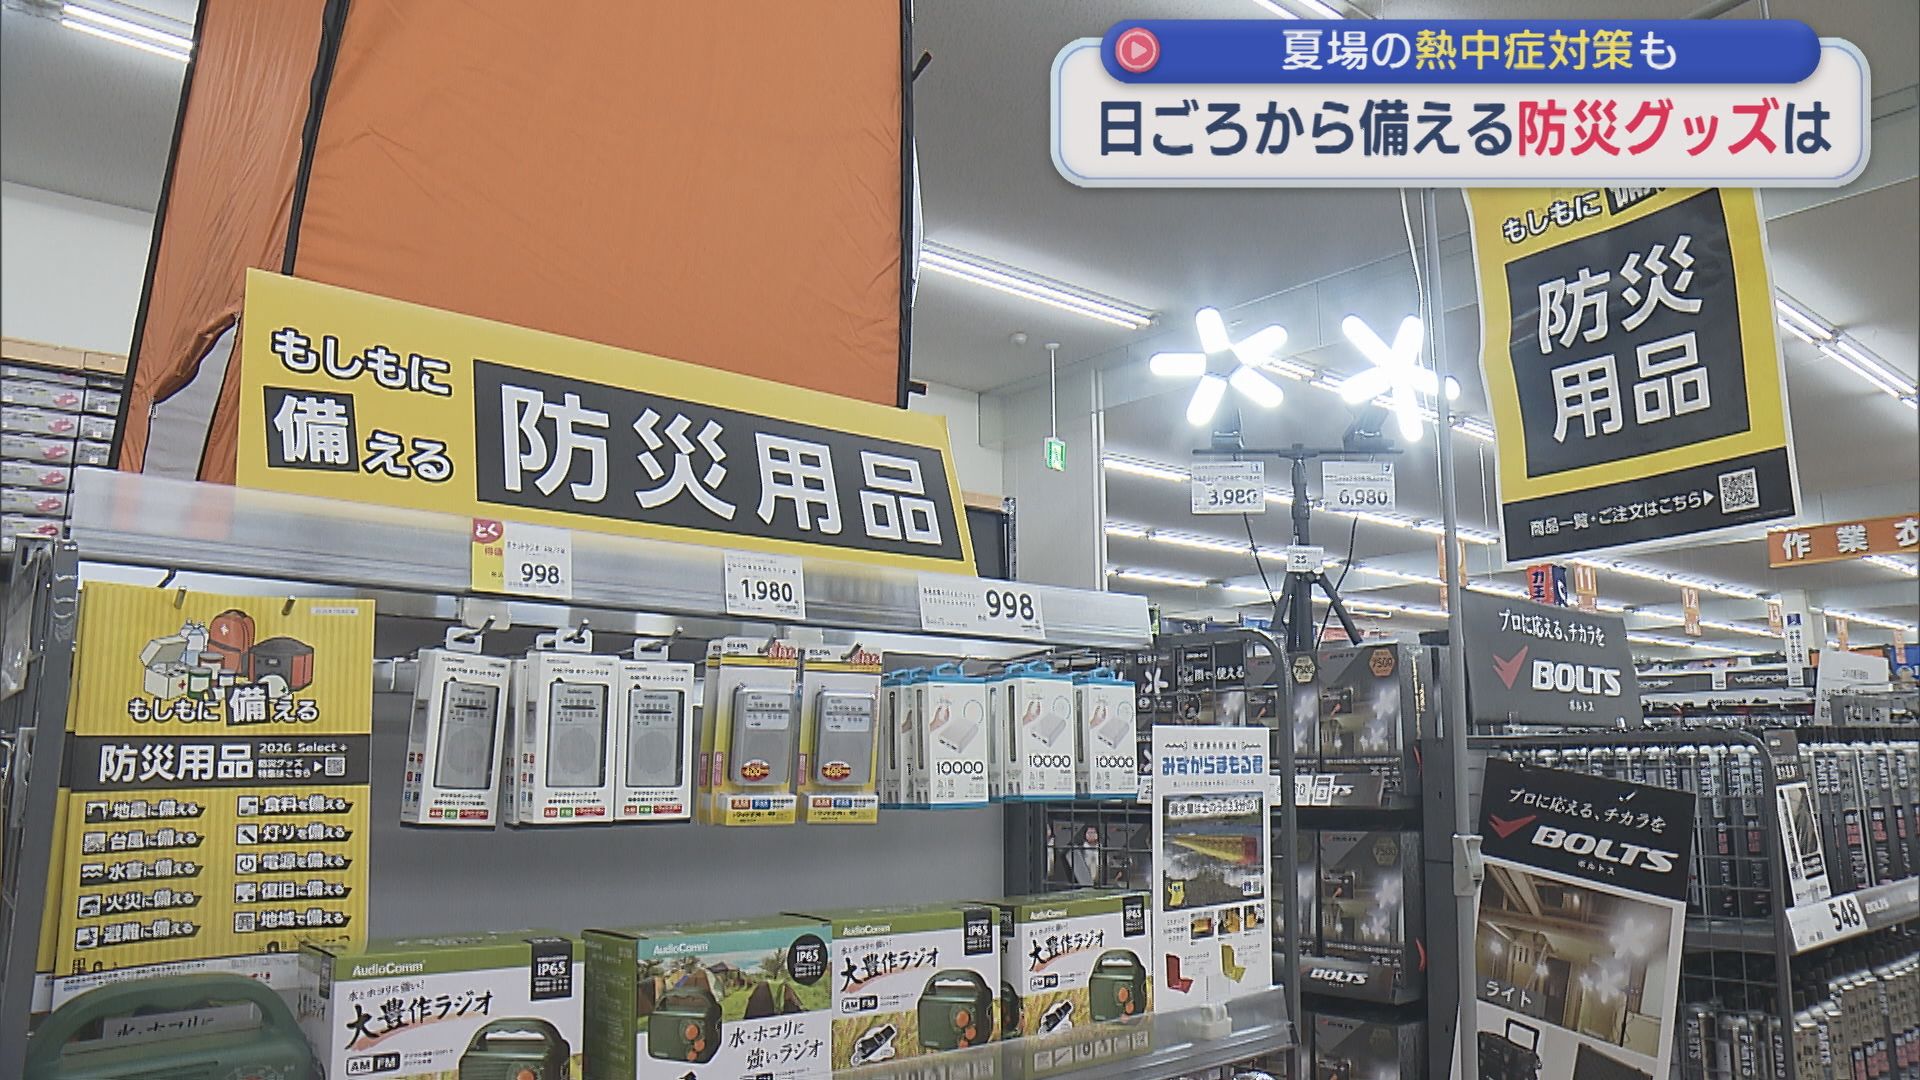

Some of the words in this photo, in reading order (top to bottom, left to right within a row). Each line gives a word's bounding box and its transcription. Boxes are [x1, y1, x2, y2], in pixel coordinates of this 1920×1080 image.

[1538, 235, 1702, 354] 防災
[272, 329, 451, 395] もしもに
[1552, 331, 1710, 442] 用品
[276, 394, 453, 480] 備える
[501, 383, 942, 545] 防災用品
[1530, 491, 1702, 537] 商品一覧・ご注文はこちら
[475, 523, 499, 538] とく
[521, 563, 560, 584] 998
[741, 579, 793, 602] 1,980
[986, 589, 1034, 621] 998
[1499, 609, 1605, 647] プロに応える、チカラを
[1532, 660, 1620, 697] BOLTS
[128, 685, 319, 723] もしもに備える
[99, 744, 253, 782] 防災用品
[936, 761, 984, 775] 10000
[1028, 755, 1071, 768] 10000
[1096, 756, 1134, 768] 10000
[113, 800, 198, 818] 地震に備える
[263, 794, 346, 812] 食料を備える
[1509, 788, 1667, 834] プロに応える、チカラを
[111, 828, 197, 850] 台風に備える
[262, 823, 345, 841] 灯りを備える
[262, 852, 345, 869] 電源を備える
[1531, 825, 1679, 873] BOLTS
[108, 859, 195, 880] 水害に備える
[106, 889, 194, 912] 火災に備える
[262, 880, 344, 900] 復旧に備える
[261, 909, 344, 928] 地域で備える
[1828, 898, 1860, 931] 548
[103, 919, 194, 943] 避難に備える
[842, 924, 891, 936] AudioComm
[968, 924, 989, 936] IP65
[653, 943, 709, 956] AudioComm
[796, 950, 819, 963] IP65
[352, 963, 424, 977] AudioComm
[537, 961, 566, 976] IP65
[840, 948, 940, 992] 大豊作ラジオ
[845, 1001, 858, 1010] AM
[862, 999, 875, 1008] FM
[1486, 980, 1532, 1008] ライト
[344, 990, 494, 1050] 大豊作ラジオ
[728, 1019, 805, 1048] 水・ホコリに
[350, 1061, 371, 1072] AM
[376, 1057, 396, 1069] FM
[747, 1039, 824, 1070] 強いラジオ
